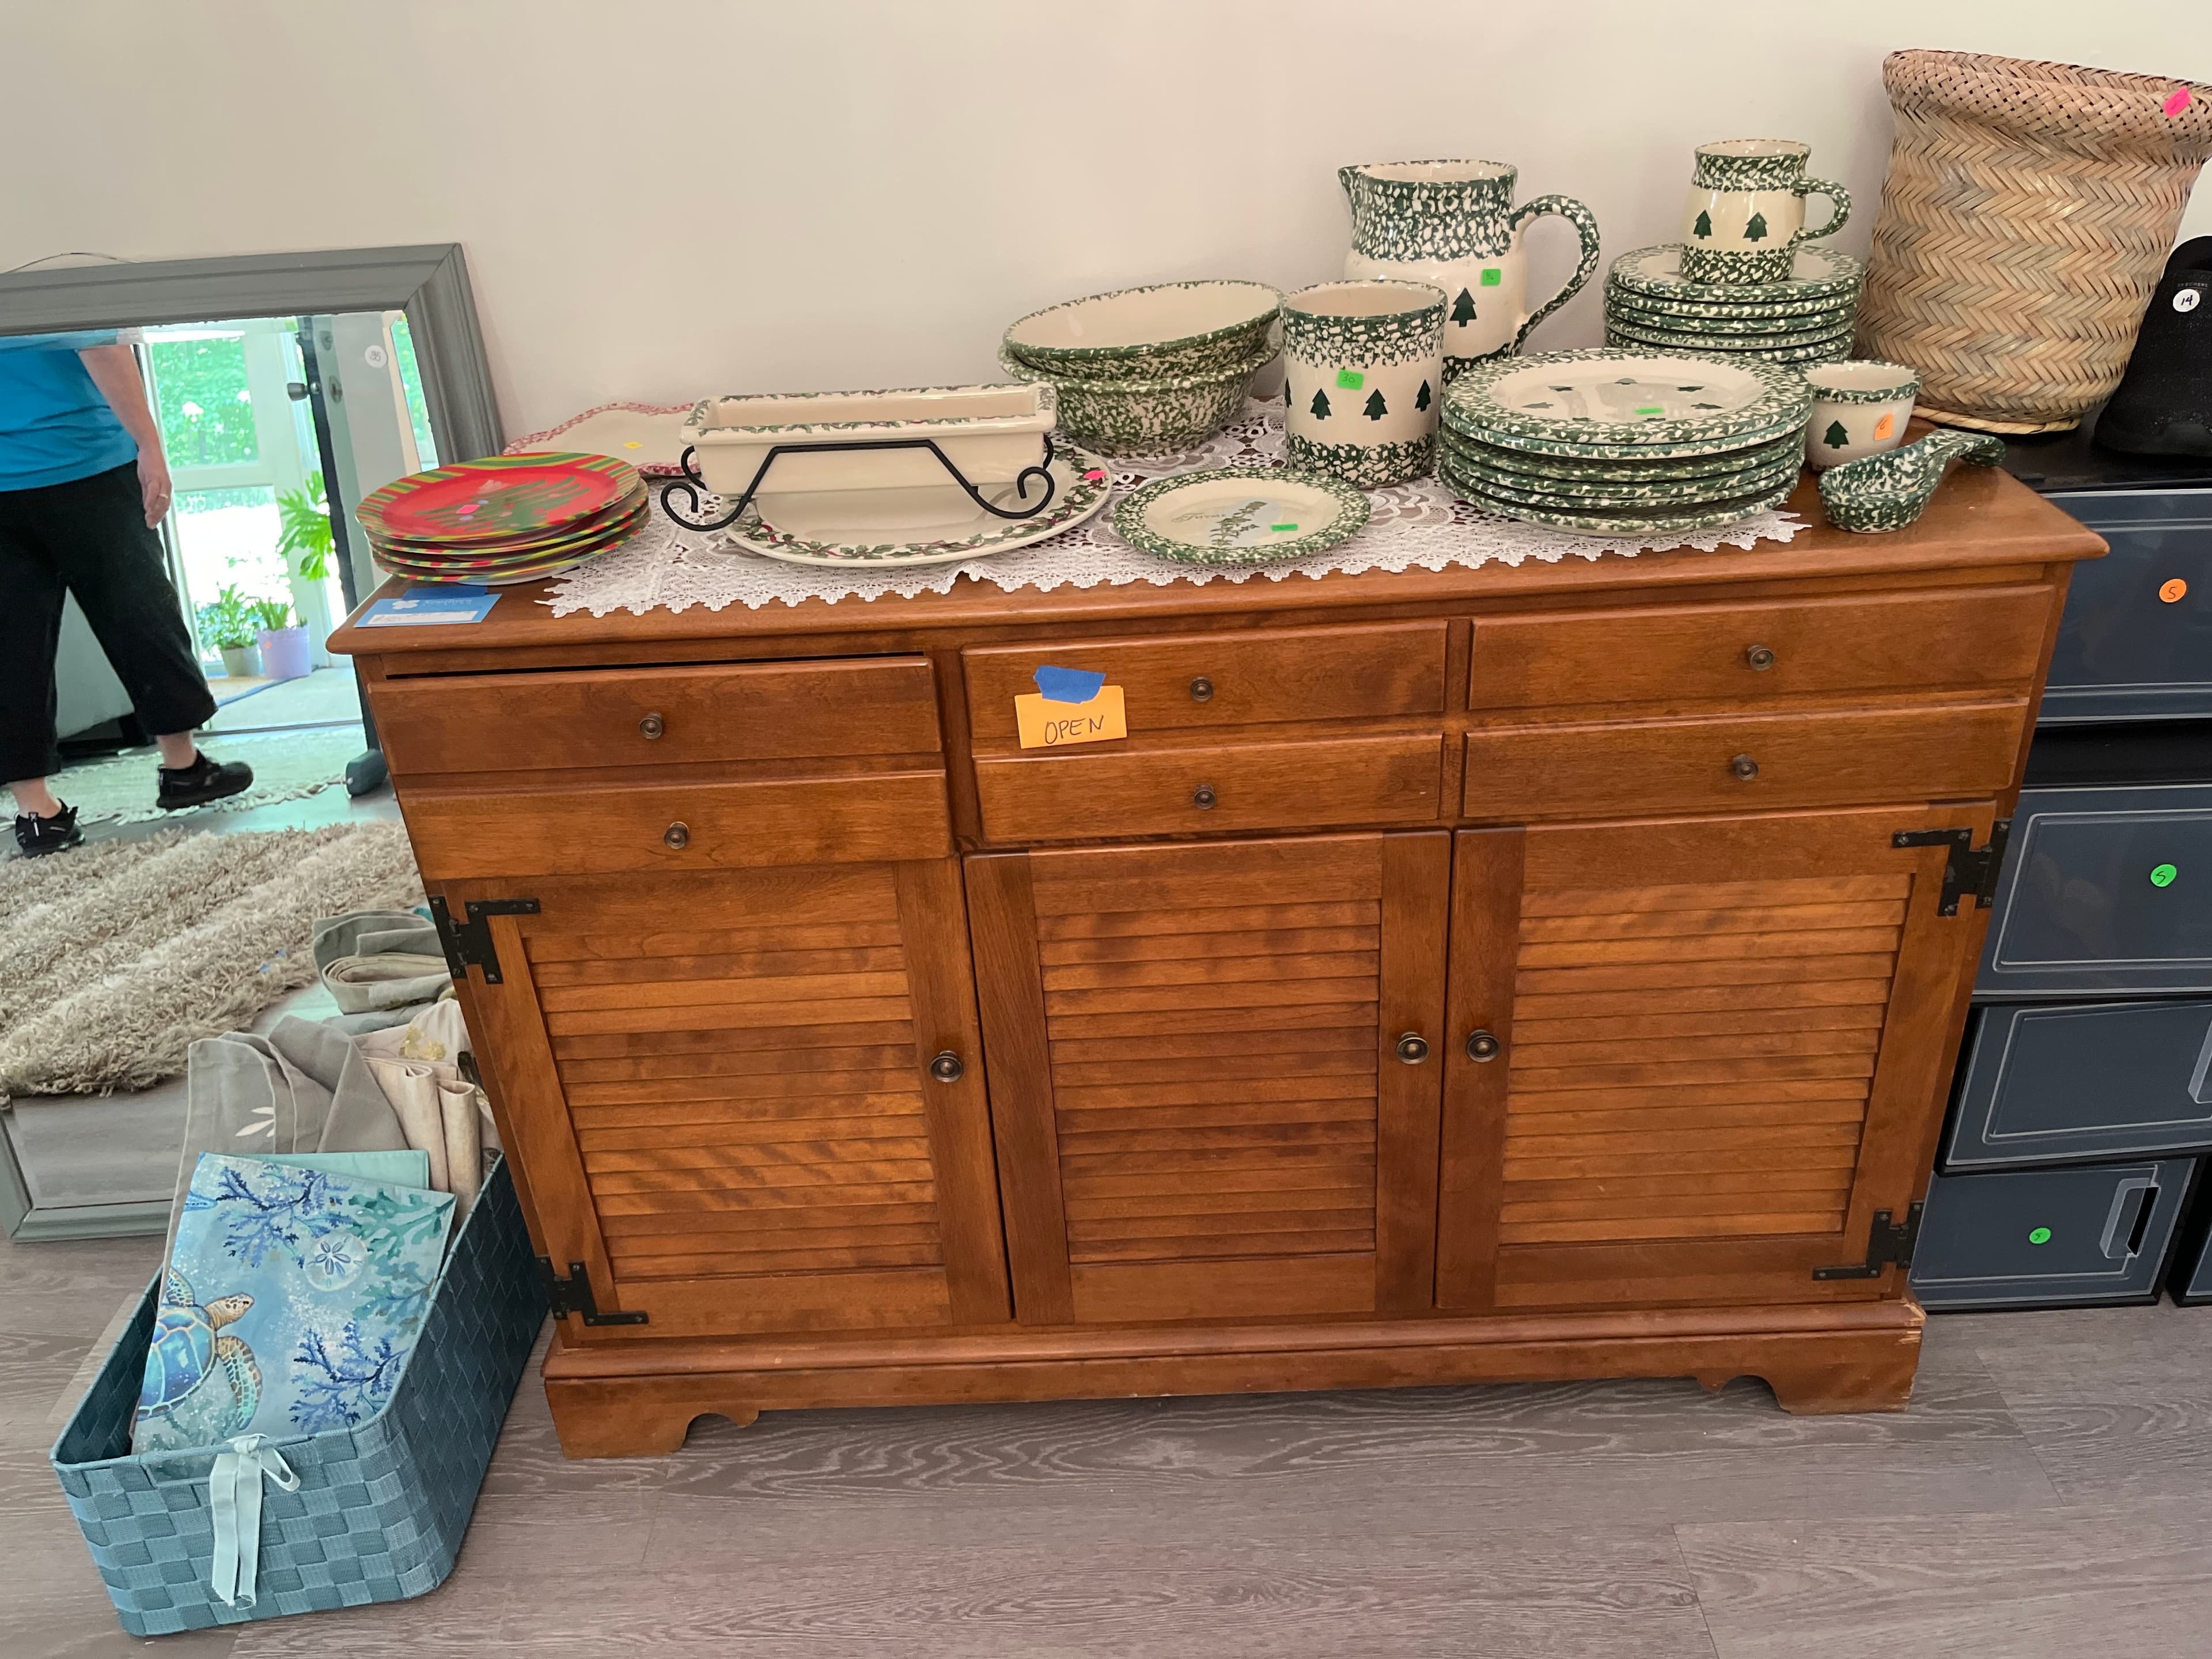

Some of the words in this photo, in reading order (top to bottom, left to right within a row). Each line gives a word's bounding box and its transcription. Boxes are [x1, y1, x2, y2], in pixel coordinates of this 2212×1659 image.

[2180, 294, 2193, 306] 14
[1342, 373, 1355, 383] 30
[1880, 419, 1888, 430] 6
[1044, 714, 1104, 744] OPEN
